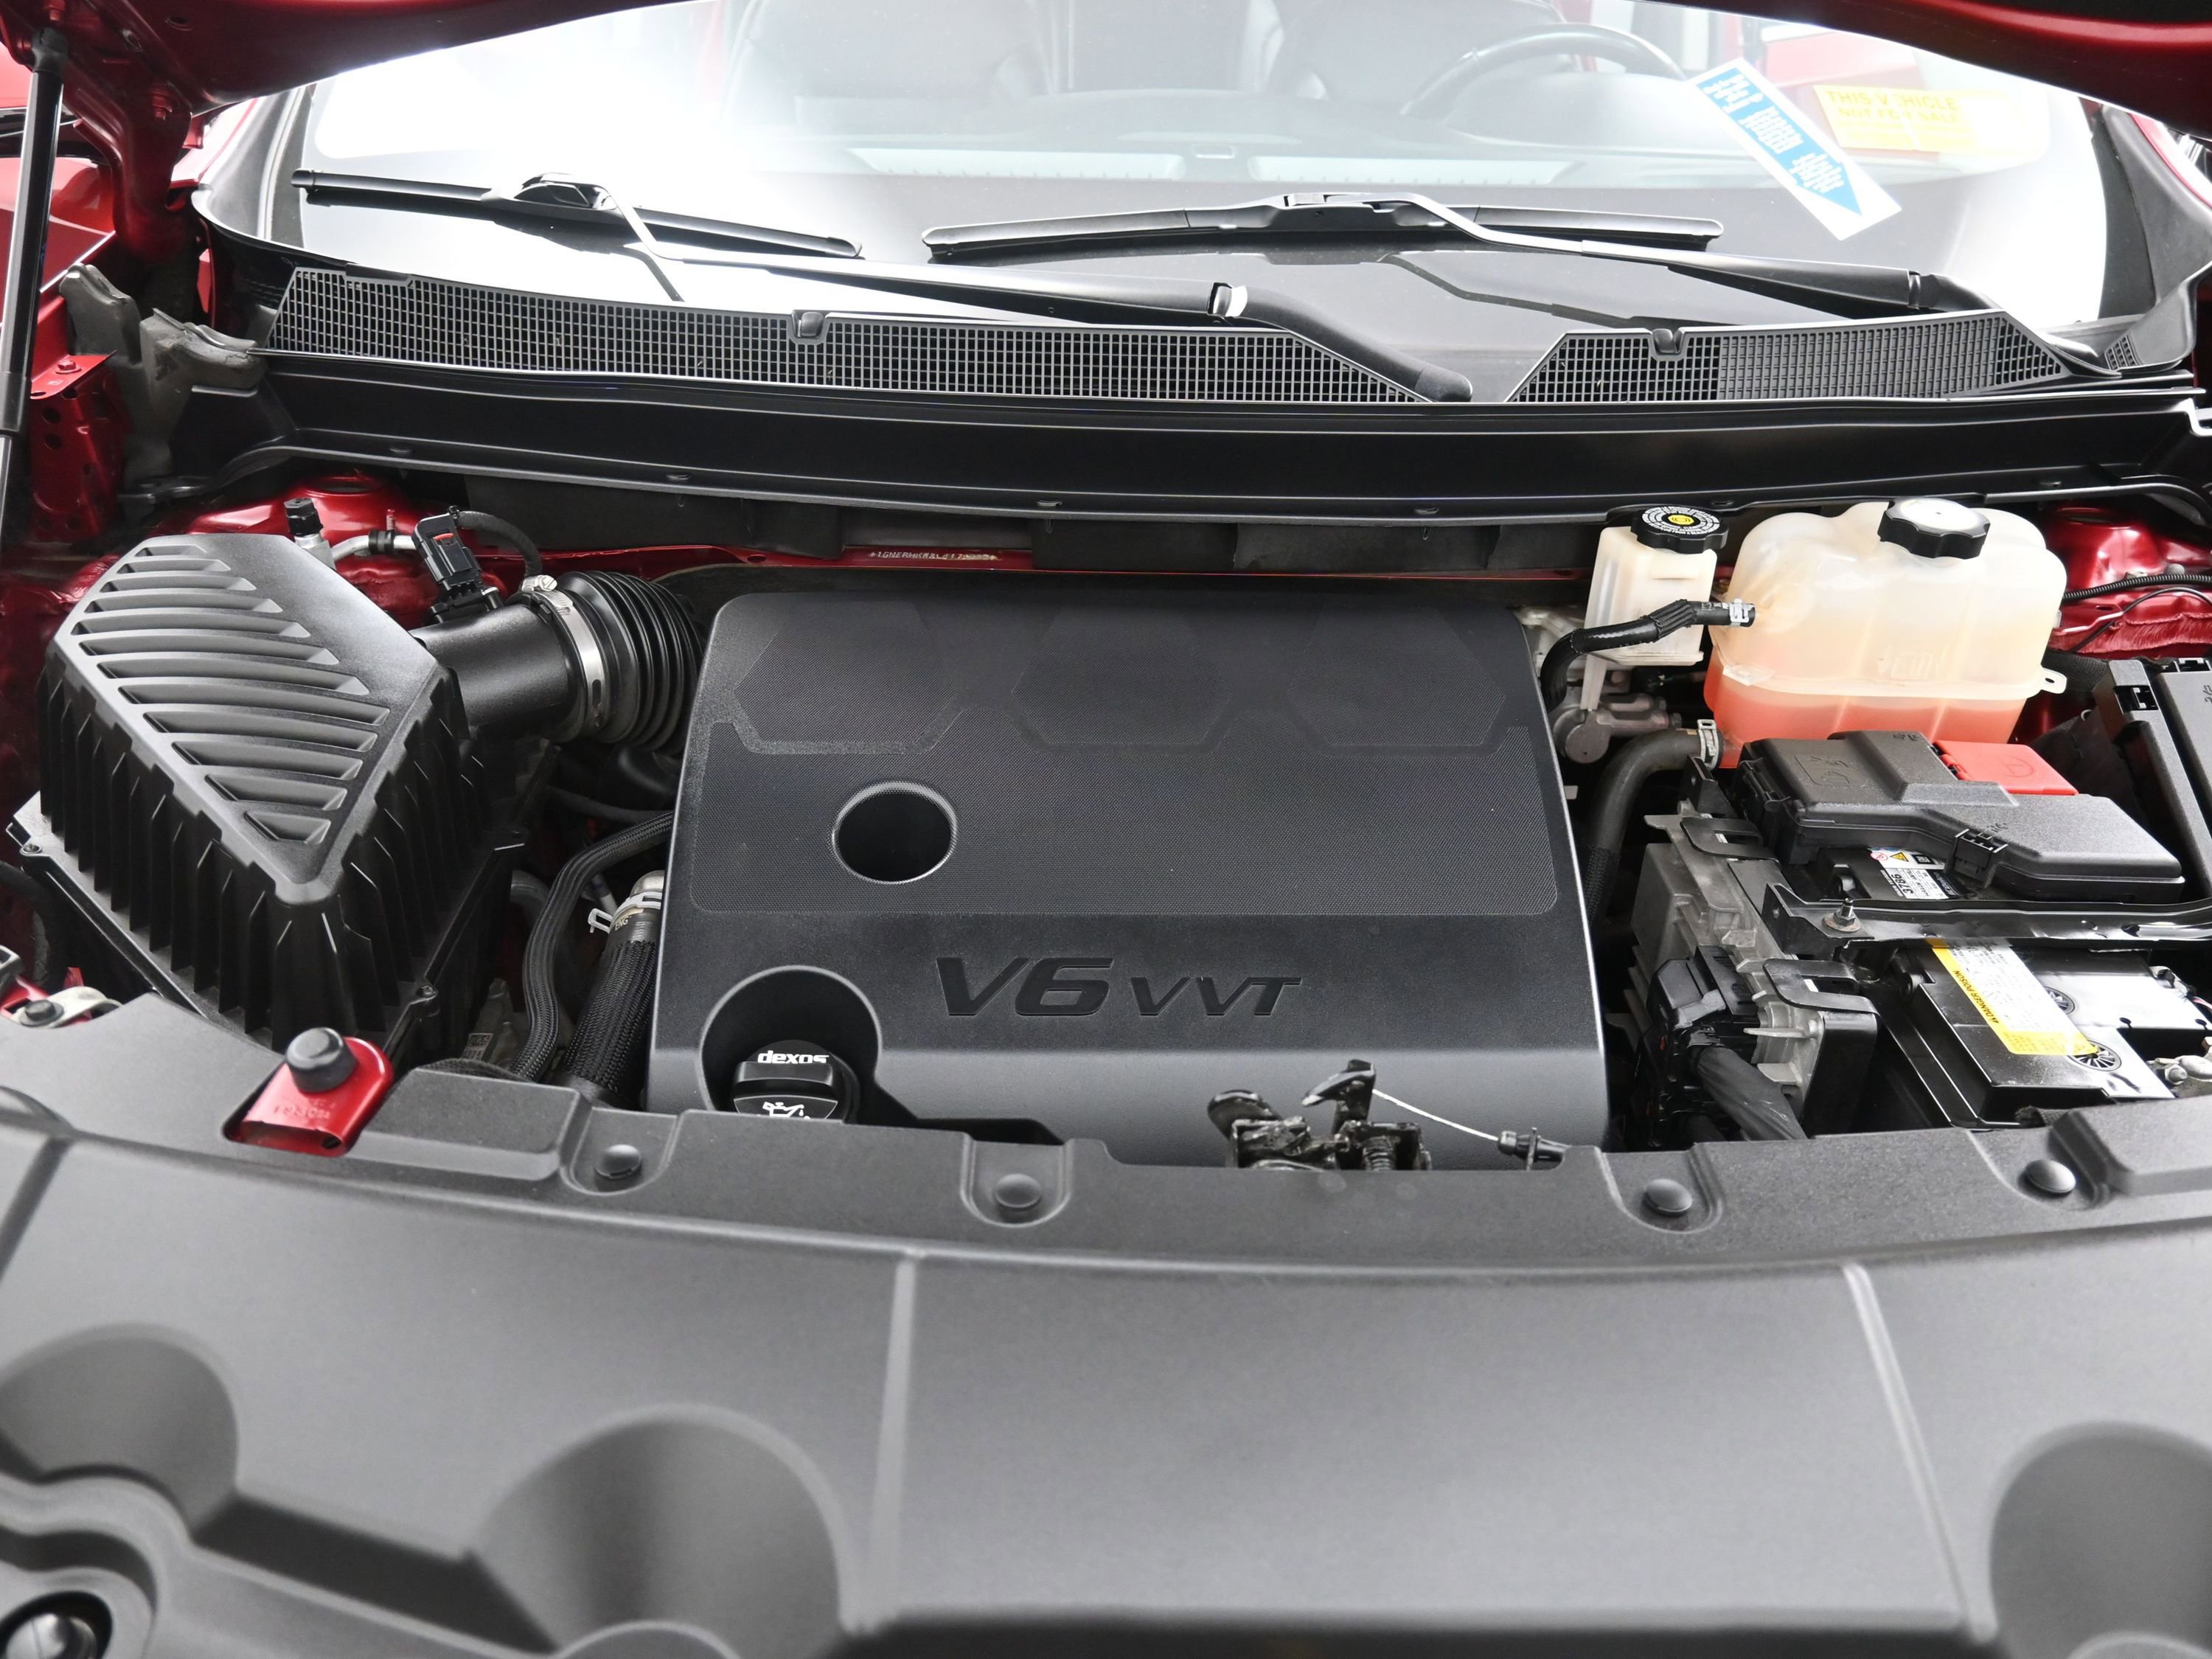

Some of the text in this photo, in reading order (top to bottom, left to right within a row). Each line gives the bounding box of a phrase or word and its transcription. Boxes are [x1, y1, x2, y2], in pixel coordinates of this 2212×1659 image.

[1826, 91, 1958, 110] THIS VEHICLE
[1838, 107, 1871, 119] NOT
[1891, 874, 1914, 894] 3786
[936, 957, 1301, 1017] V6 VVT
[1952, 970, 1975, 992] POISON
[1971, 992, 1994, 1017] DANGER
[757, 1050, 830, 1064] dexos
